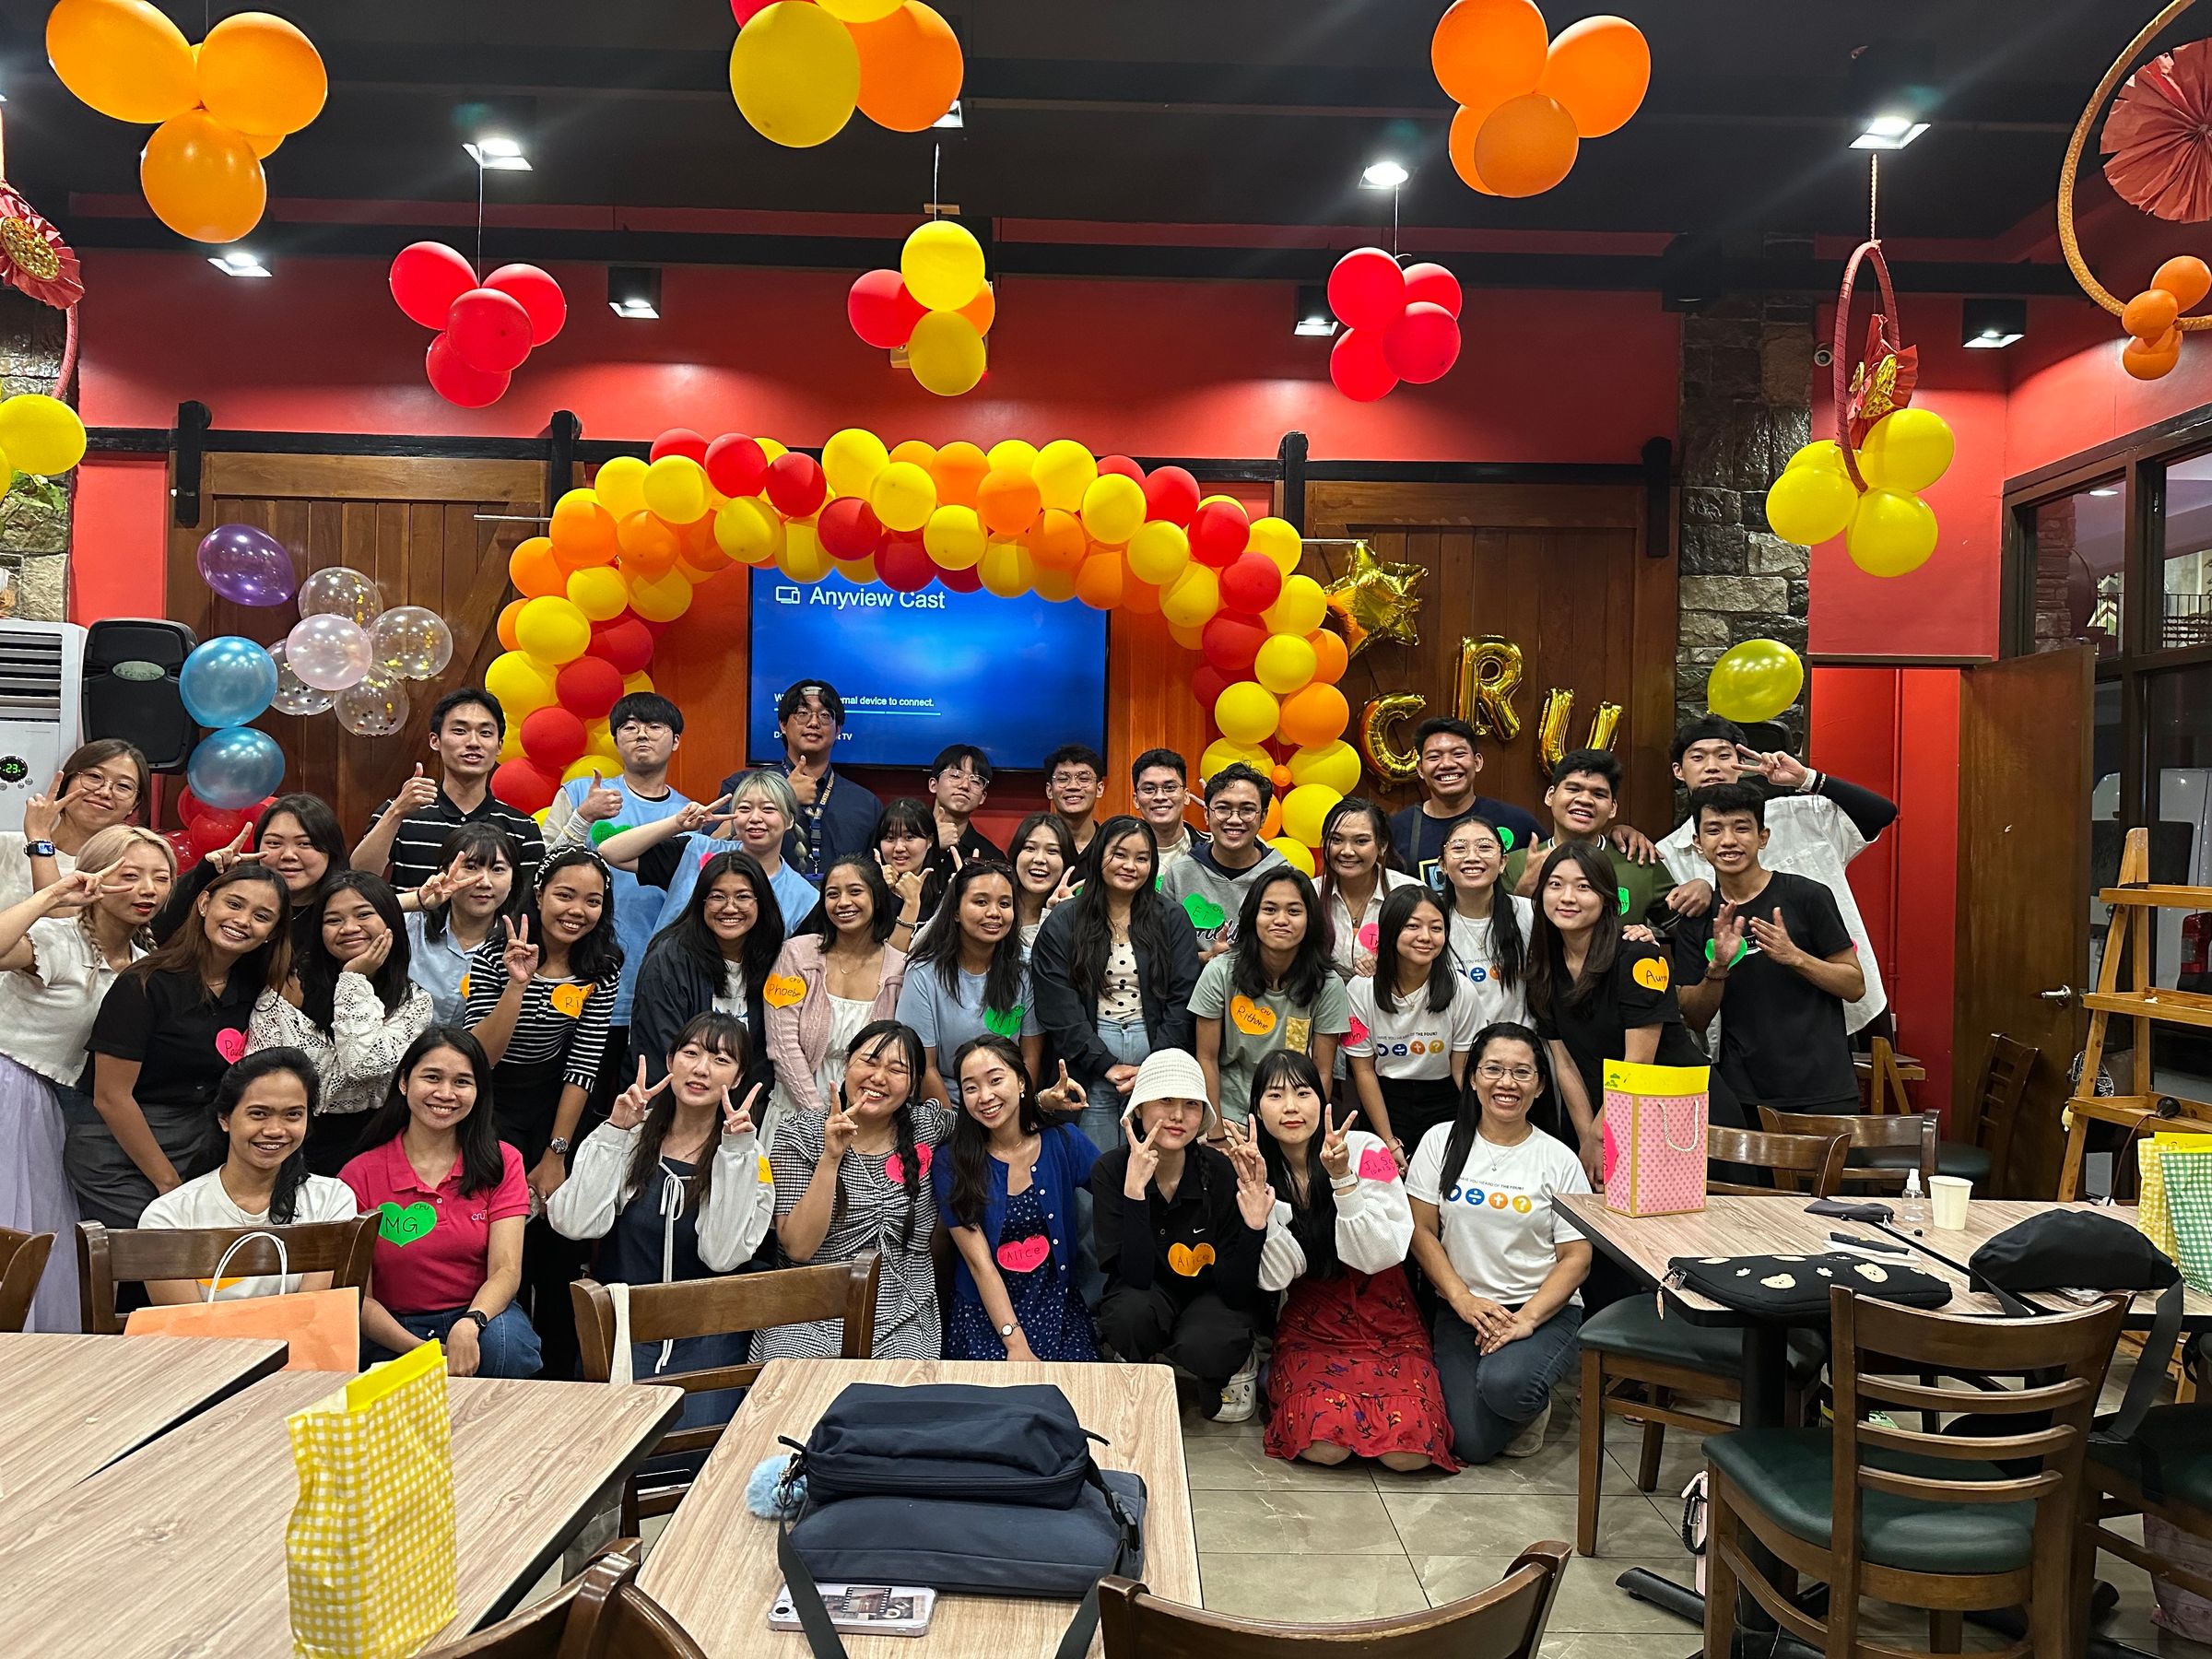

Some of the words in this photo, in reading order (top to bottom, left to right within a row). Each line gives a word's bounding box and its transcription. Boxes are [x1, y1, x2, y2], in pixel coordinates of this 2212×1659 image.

[809, 586, 893, 610] Anyview
[899, 591, 946, 609] Cast
[859, 696, 887, 705] device
[888, 697, 898, 706] to
[899, 698, 935, 707] connect.
[842, 733, 853, 741] TV
[767, 983, 801, 998] Phoebe
[385, 1216, 418, 1234] MG
[1006, 1246, 1041, 1263] Alice
